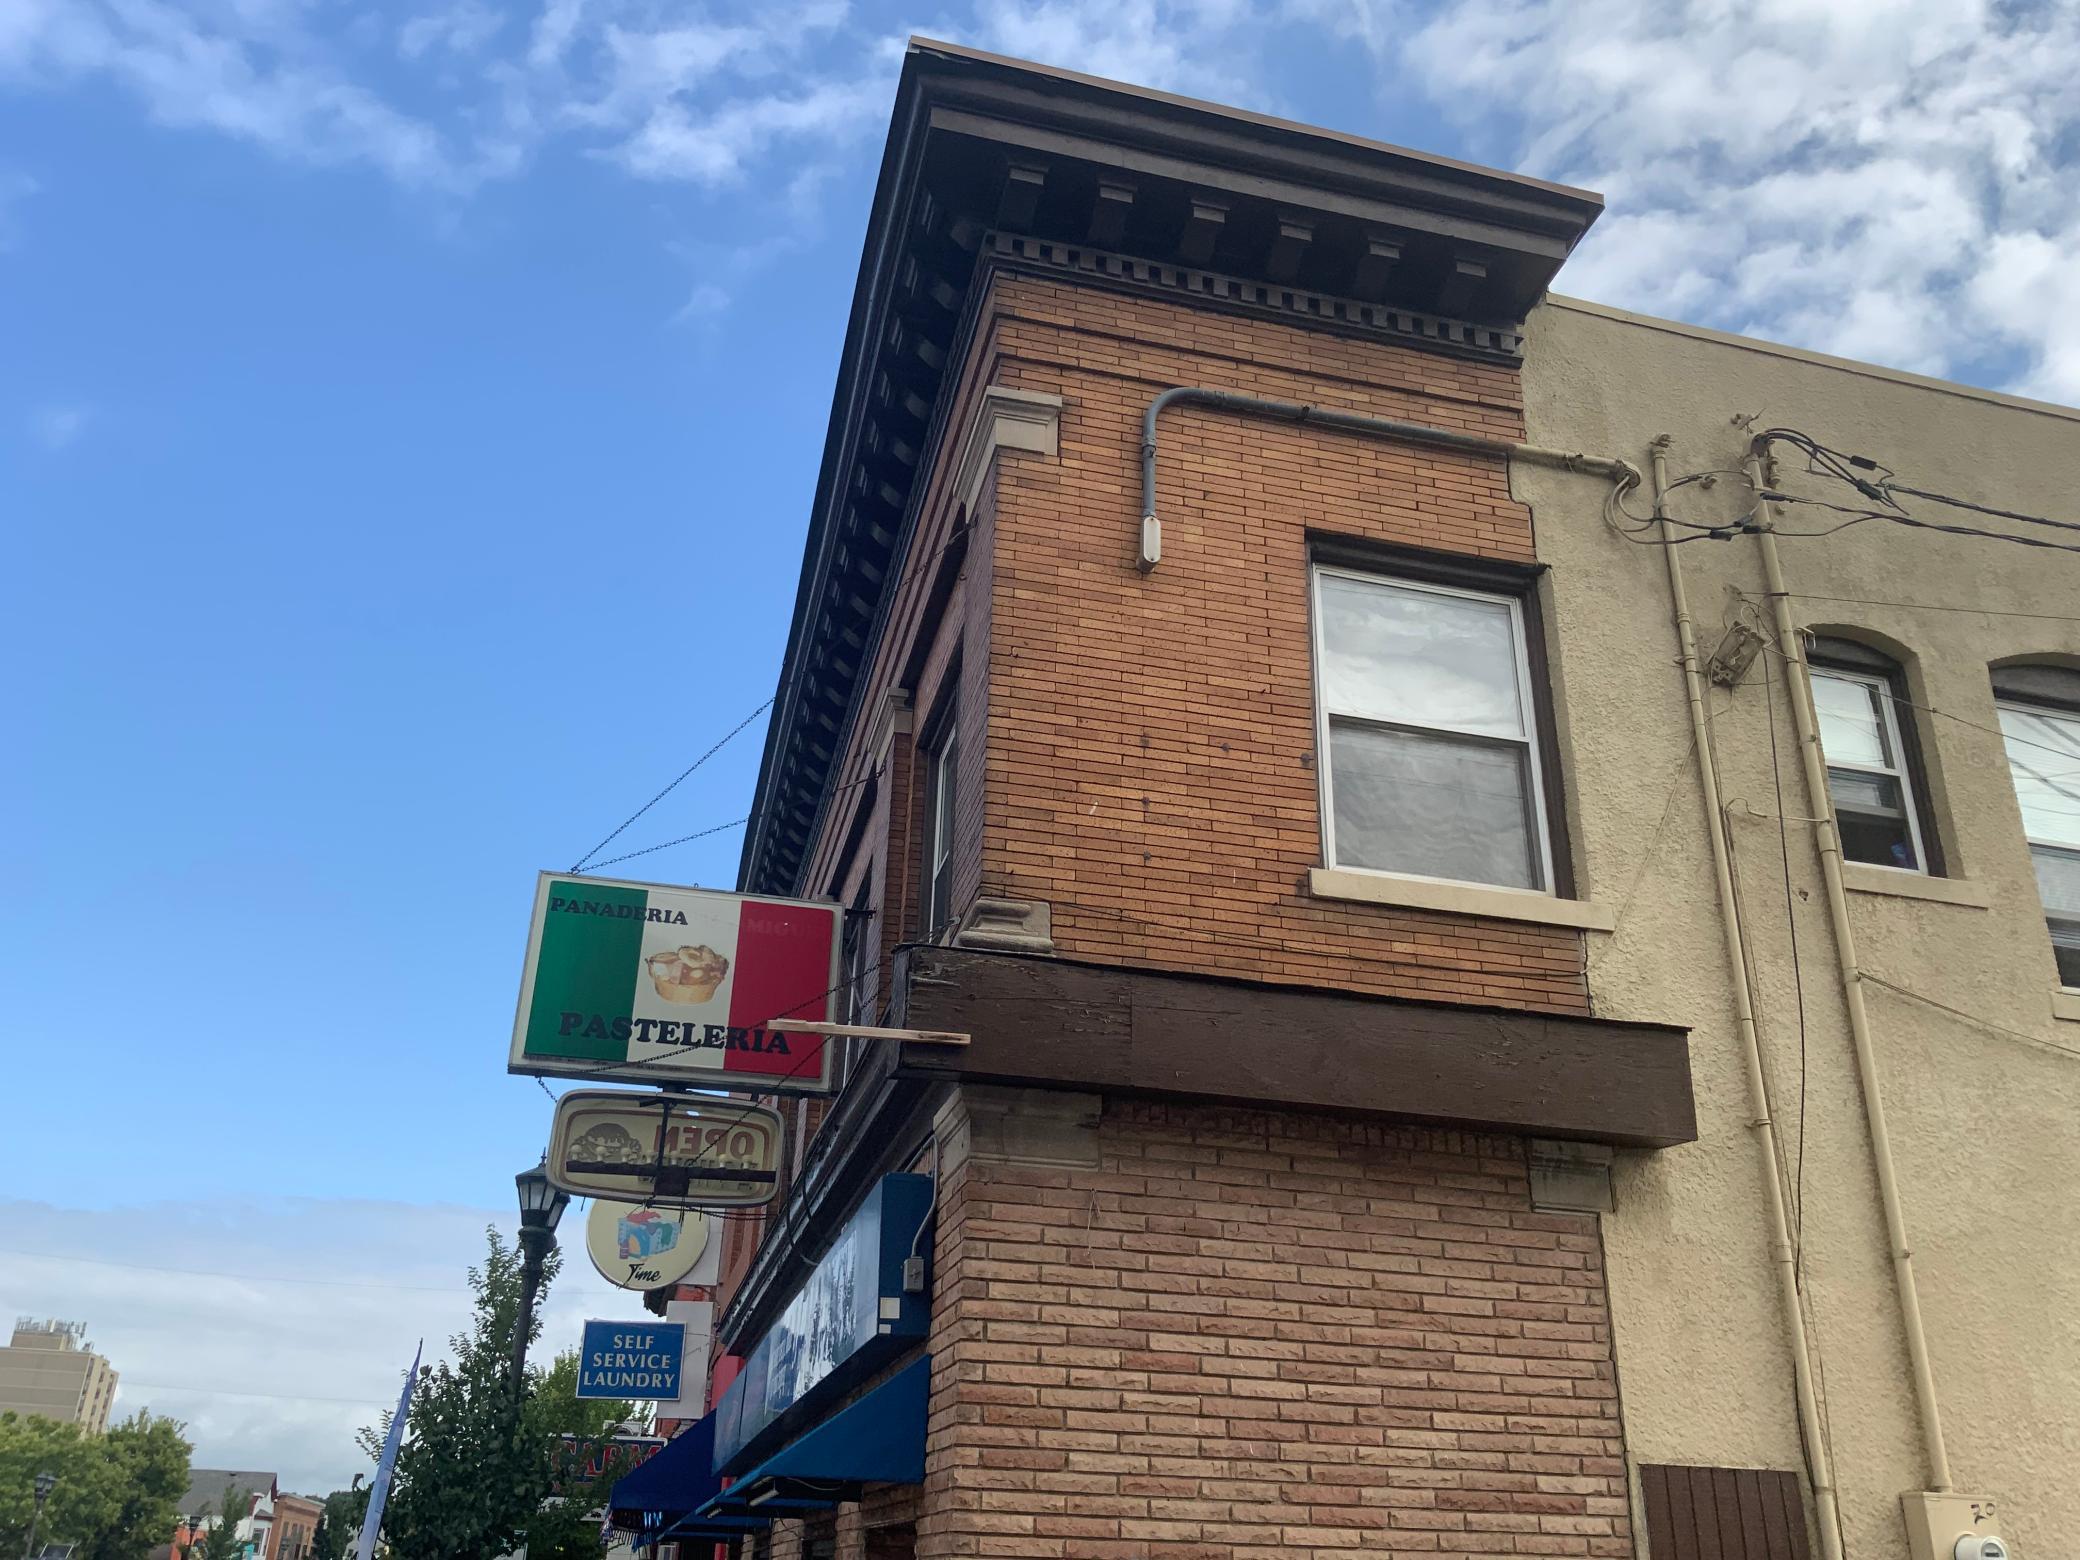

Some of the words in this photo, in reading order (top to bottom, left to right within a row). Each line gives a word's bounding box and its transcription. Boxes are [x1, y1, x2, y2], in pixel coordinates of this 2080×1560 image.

[551, 897, 688, 926] PANADERIA
[558, 1012, 792, 1055] PASTELERIA
[623, 1263, 661, 1284] Time
[613, 1335, 655, 1350] SELF
[593, 1353, 672, 1369] SERVICE
[583, 1371, 675, 1388] LAUNDRY
